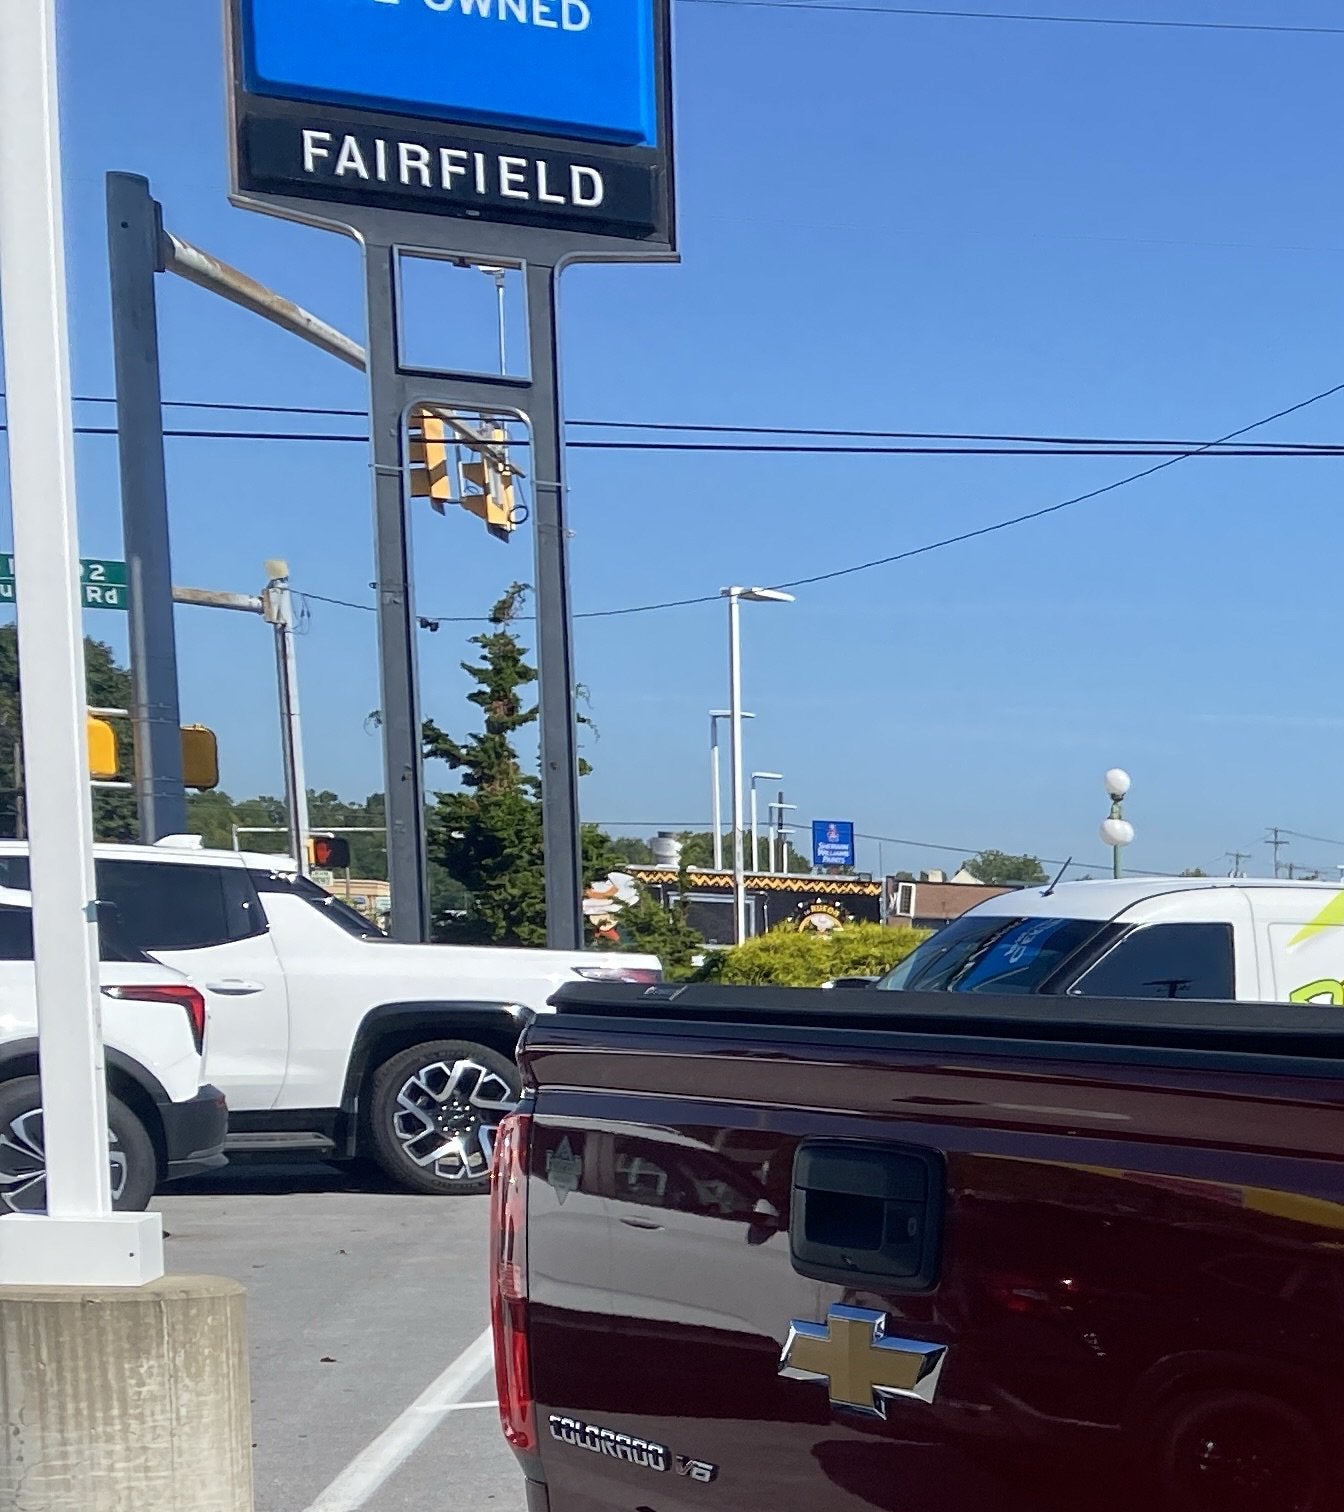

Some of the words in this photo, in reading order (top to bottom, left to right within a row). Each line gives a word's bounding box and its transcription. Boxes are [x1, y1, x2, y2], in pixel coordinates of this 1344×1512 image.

[302, 129, 606, 208] FAIRFIELD
[86, 585, 119, 605] Rd
[549, 1415, 669, 1472] COLORADO
[676, 1454, 717, 1483] V6
